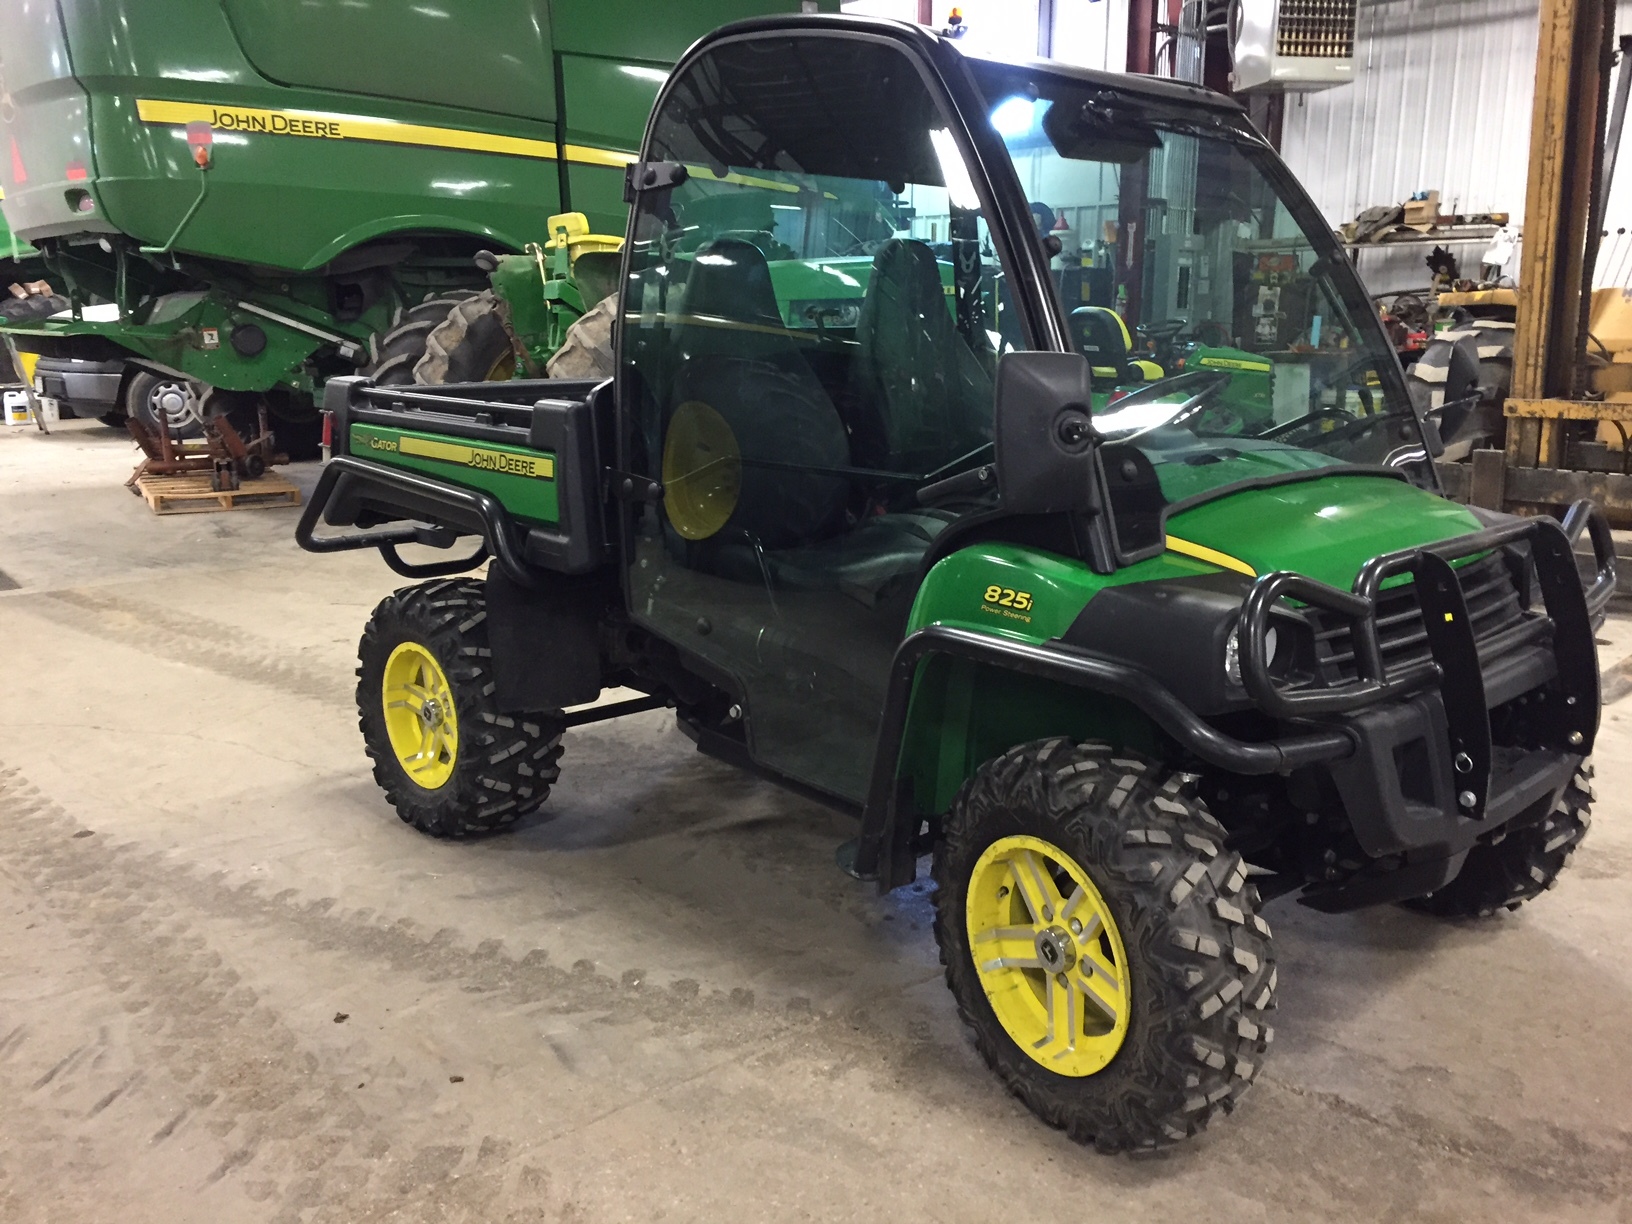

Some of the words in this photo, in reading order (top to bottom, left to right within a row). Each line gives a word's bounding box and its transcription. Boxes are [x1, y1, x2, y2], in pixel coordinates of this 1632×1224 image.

[210, 109, 267, 131] JOHN
[271, 114, 342, 136] DEERE
[370, 437, 398, 452] GATOR
[467, 449, 497, 469] JOHN
[499, 454, 537, 475] DEERE
[983, 585, 1034, 611] 825i
[980, 604, 1002, 615] Power
[1002, 609, 1032, 624] Steering
